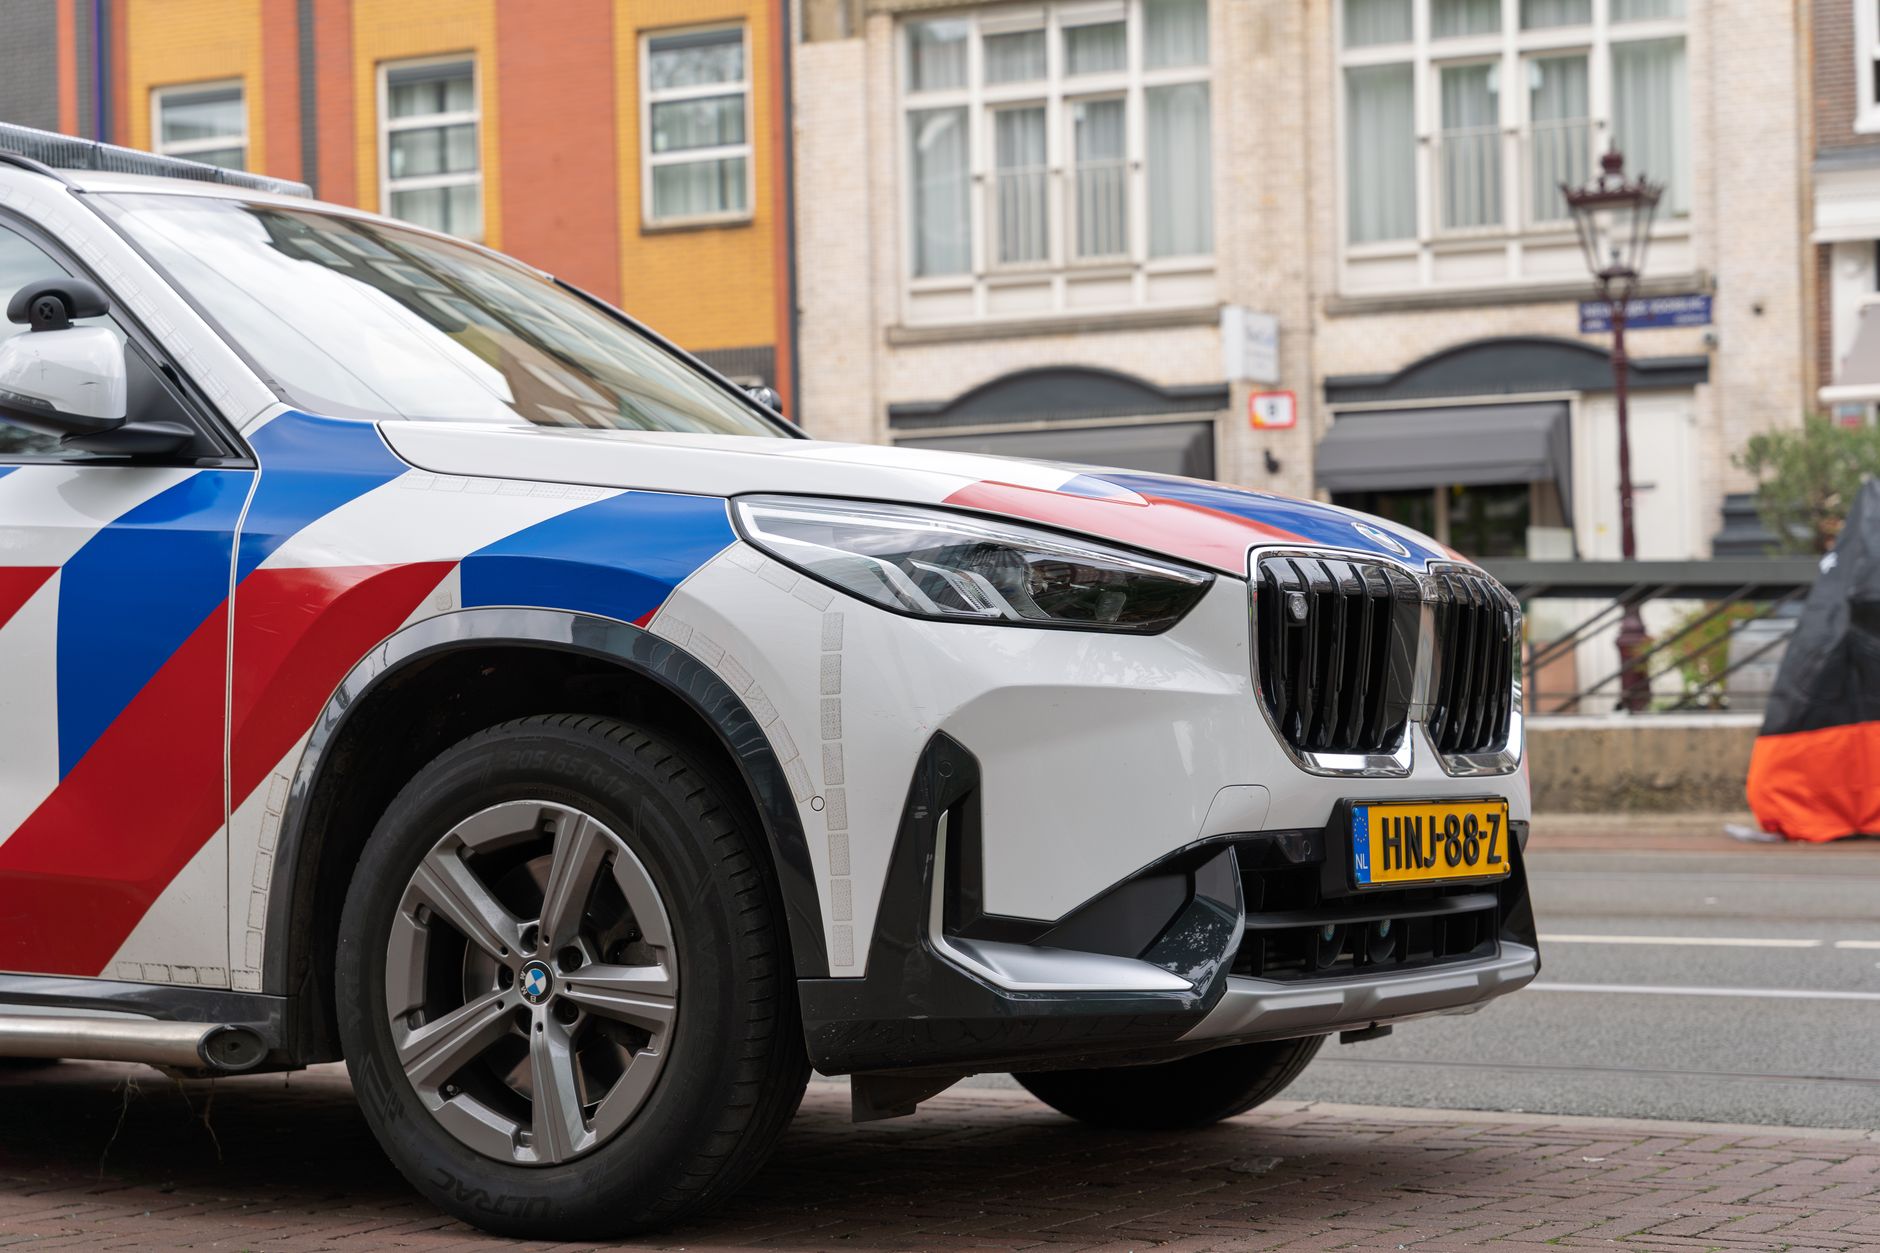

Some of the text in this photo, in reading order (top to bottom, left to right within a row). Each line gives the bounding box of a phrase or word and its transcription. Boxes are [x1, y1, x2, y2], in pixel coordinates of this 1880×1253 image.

[1355, 852, 1369, 870] NL
[1382, 812, 1502, 871] HNJ-88-Z
[428, 1167, 552, 1218] ULTRAC
